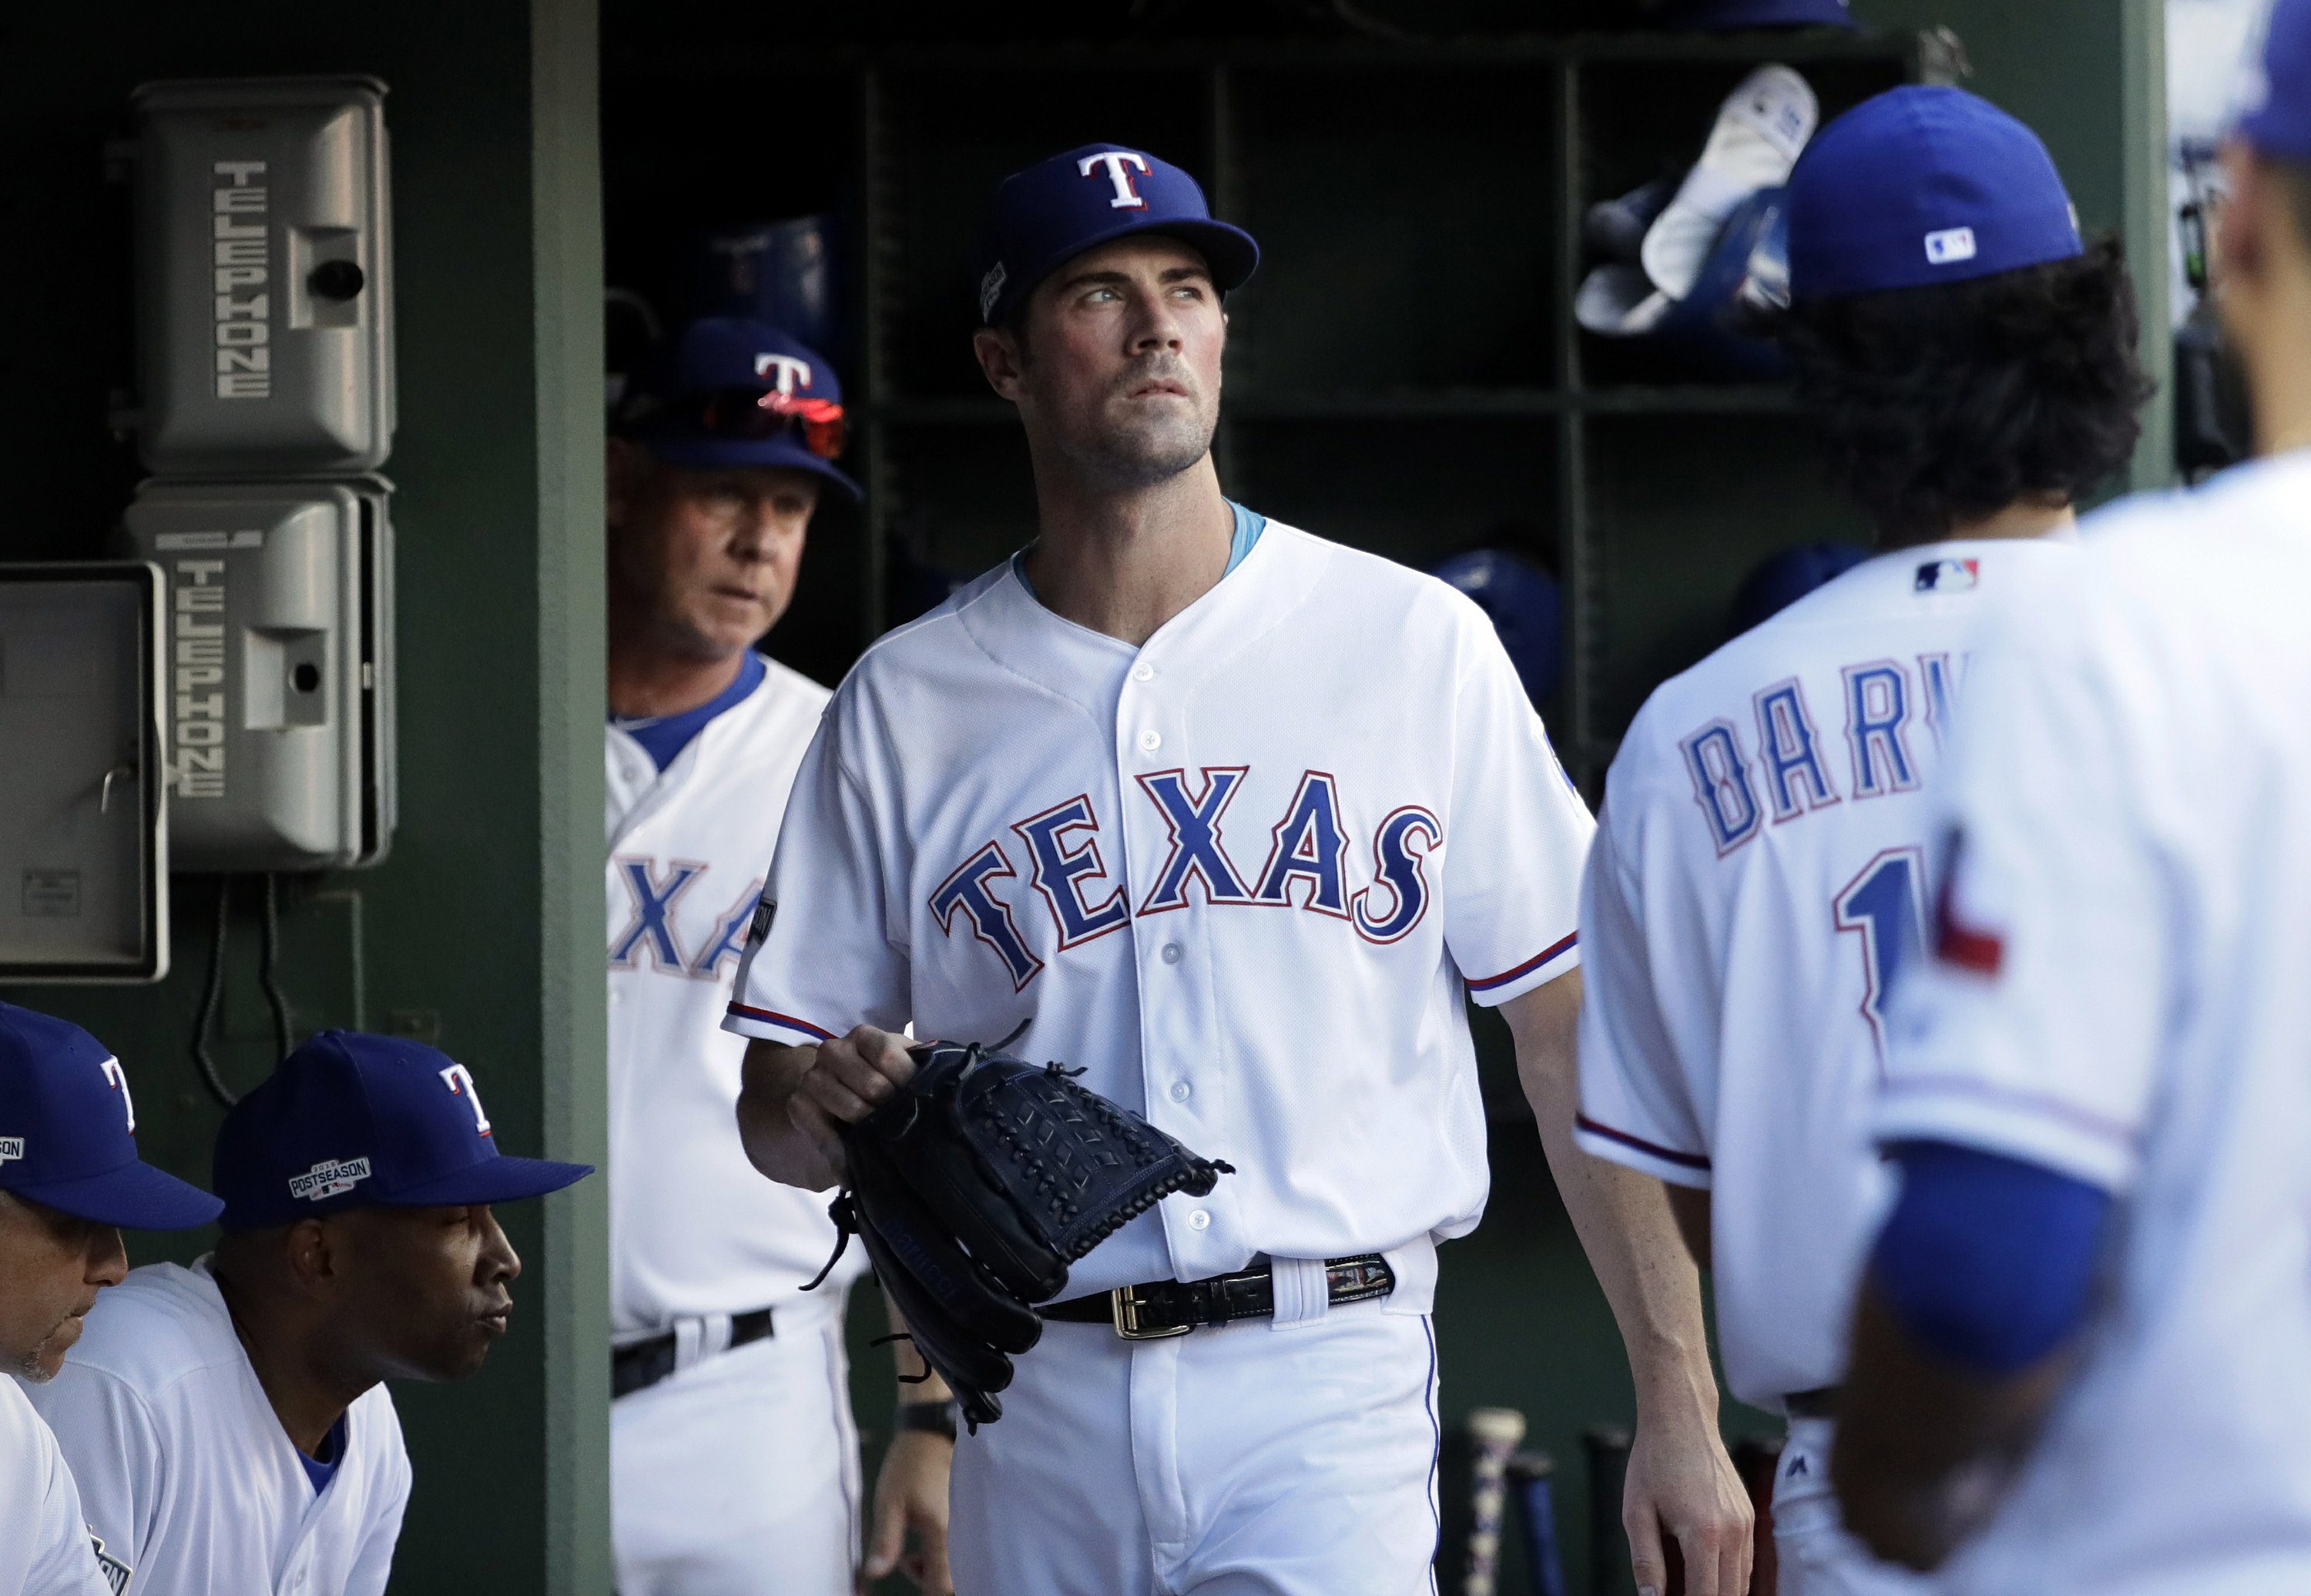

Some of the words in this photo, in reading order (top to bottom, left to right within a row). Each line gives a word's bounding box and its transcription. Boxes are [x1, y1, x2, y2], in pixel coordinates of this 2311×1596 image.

[1077, 152, 1152, 211] T
[213, 160, 270, 399] TELEPHONE
[754, 352, 813, 397] T
[176, 559, 225, 798] TELEPHONE
[928, 765, 1444, 994] TEXAS
[99, 1054, 136, 1136] T
[438, 1063, 491, 1138] T
[290, 1160, 367, 1196] POSTSEASON
